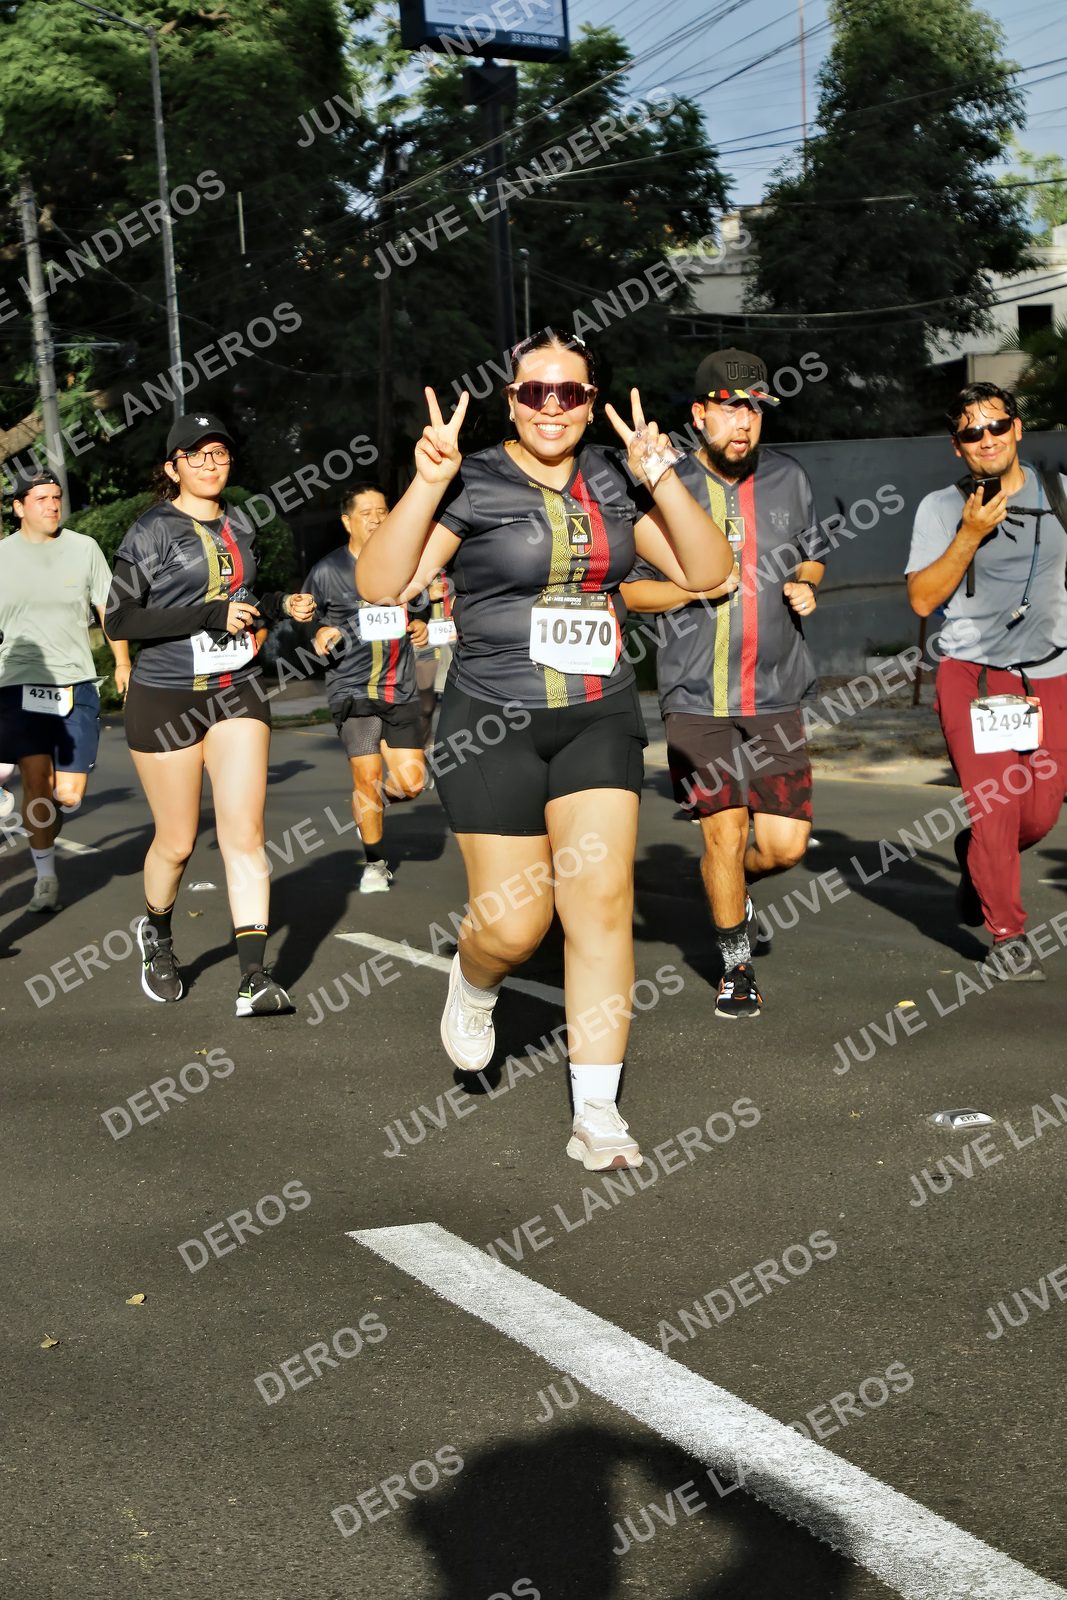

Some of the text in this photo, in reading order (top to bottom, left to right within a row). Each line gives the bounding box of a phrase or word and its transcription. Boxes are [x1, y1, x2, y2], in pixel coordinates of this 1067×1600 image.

[366, 611, 397, 626] 9451
[536, 618, 612, 646] 10570
[29, 688, 62, 701] 4216
[976, 712, 1032, 732] 12494
